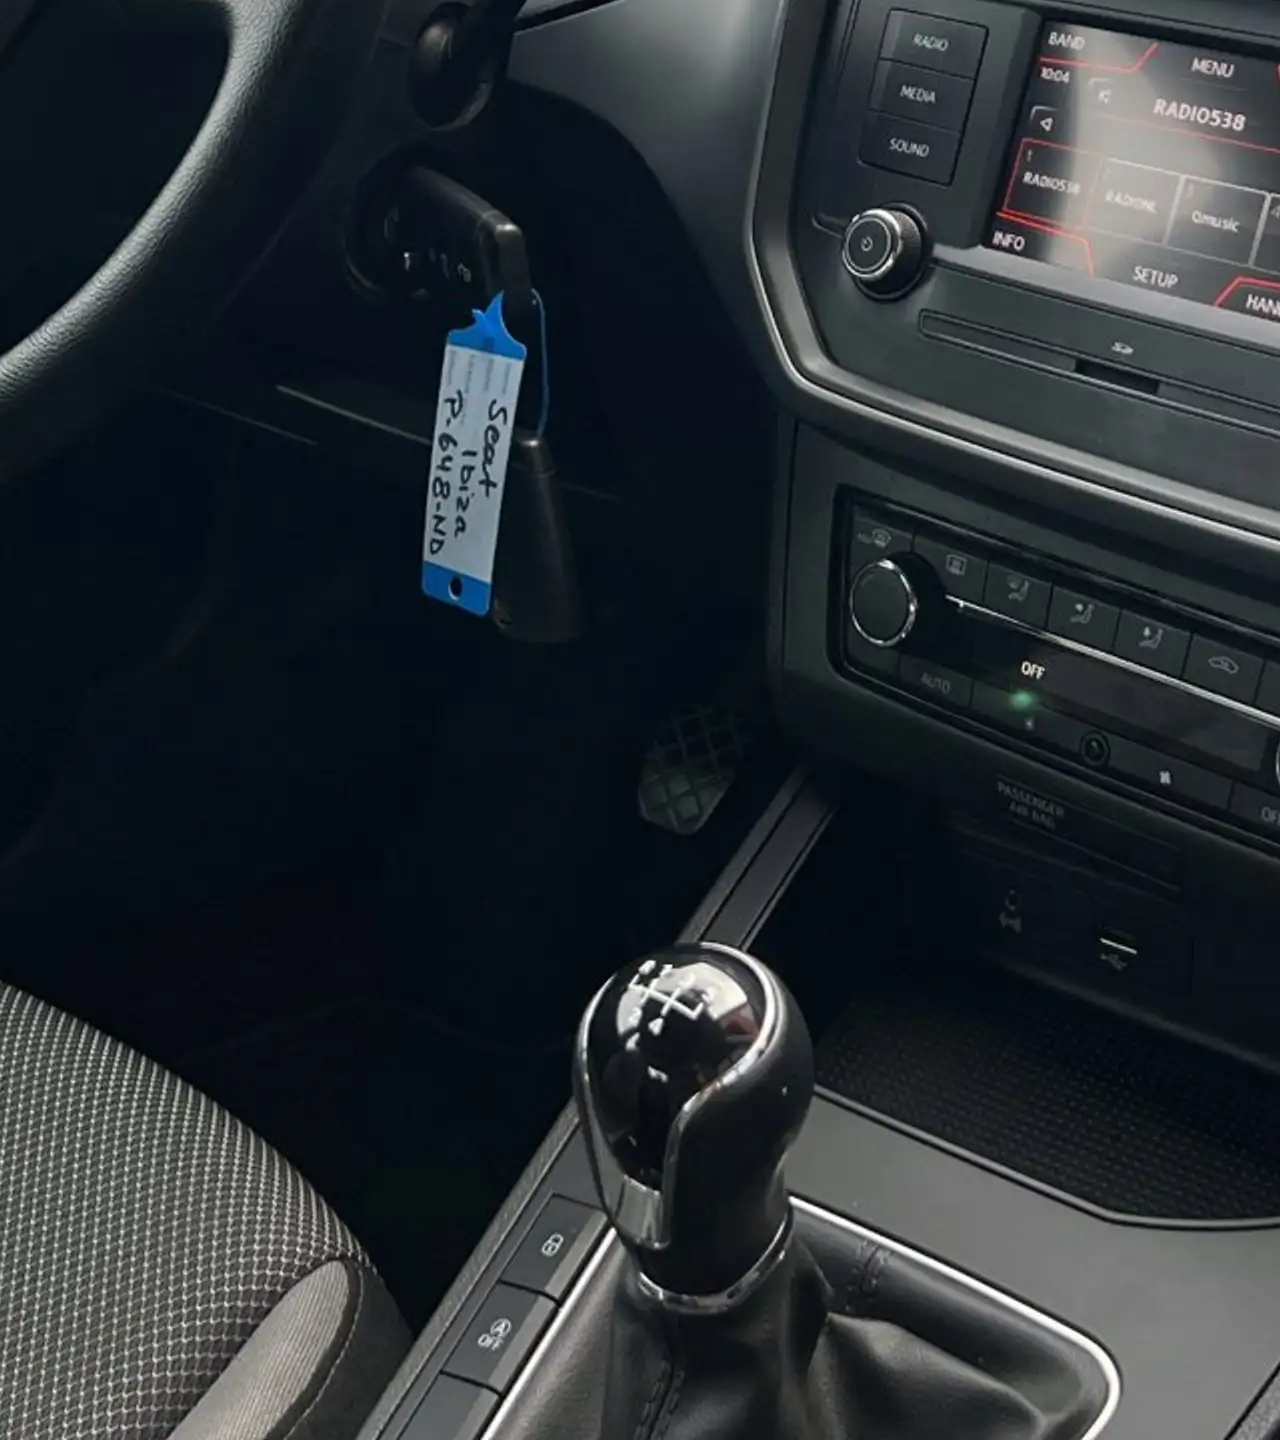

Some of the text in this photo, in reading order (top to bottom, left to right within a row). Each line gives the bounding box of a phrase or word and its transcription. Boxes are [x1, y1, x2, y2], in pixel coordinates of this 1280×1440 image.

[912, 32, 950, 51] RADIO
[1048, 31, 1085, 51] BAND
[1040, 67, 1070, 84] 10:04
[1191, 57, 1235, 79] MENU
[899, 84, 937, 104] MEDIA
[1153, 98, 1247, 132] RADIO538
[889, 137, 930, 158] SOUND
[1191, 210, 1242, 233] Qmusic
[992, 230, 1025, 251] INFO
[1132, 265, 1179, 289] SETUP
[478, 398, 508, 498] Seat
[1021, 660, 1046, 680] OFF
[921, 672, 951, 694] AUTO
[997, 781, 1065, 819] PASSENGER
